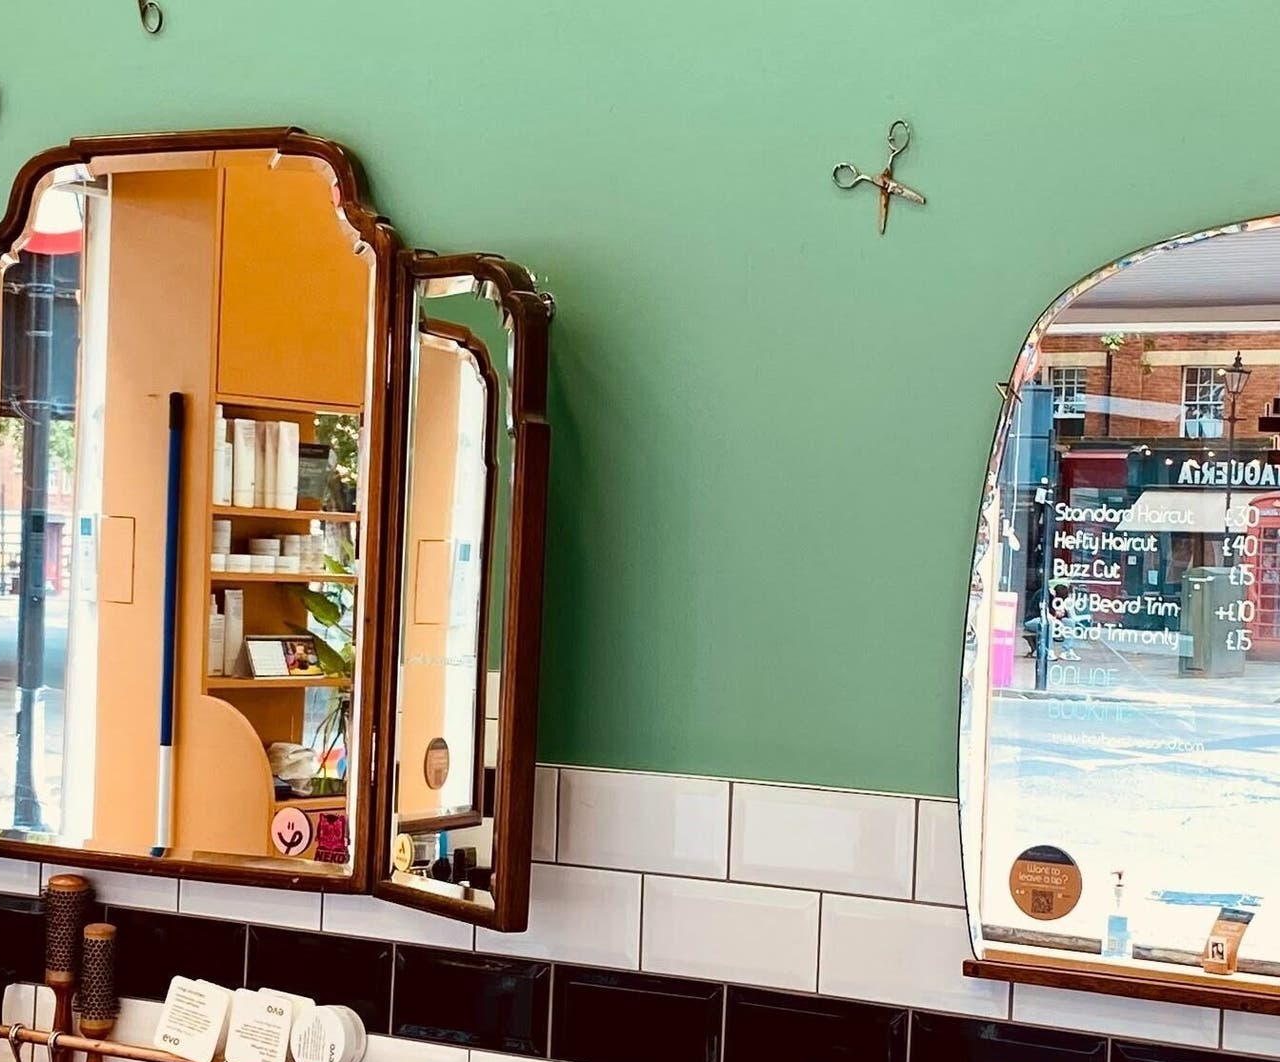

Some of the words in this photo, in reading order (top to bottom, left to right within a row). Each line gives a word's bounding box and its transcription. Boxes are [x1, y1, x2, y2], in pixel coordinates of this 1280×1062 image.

[1055, 502, 1133, 524] Standard
[1137, 506, 1195, 526] Haircut
[1224, 505, 1260, 528] £30
[1053, 530, 1100, 555] Hefty
[1101, 532, 1158, 553] Haircut
[1222, 536, 1258, 557] £40
[1053, 558, 1090, 578] Buzz
[1093, 560, 1121, 580] Cut
[1229, 564, 1255, 586] £15
[1052, 590, 1087, 611] add
[1089, 593, 1141, 615] Beard
[1144, 597, 1180, 618] Trim
[1214, 601, 1255, 623] +£10
[1053, 618, 1101, 641] Beard
[1105, 623, 1139, 644] Trim
[1141, 628, 1180, 650] only
[1226, 630, 1253, 651] £15
[314, 848, 350, 864] NEKO
[1026, 863, 1050, 874] Want
[162, 1033, 180, 1047] evo
